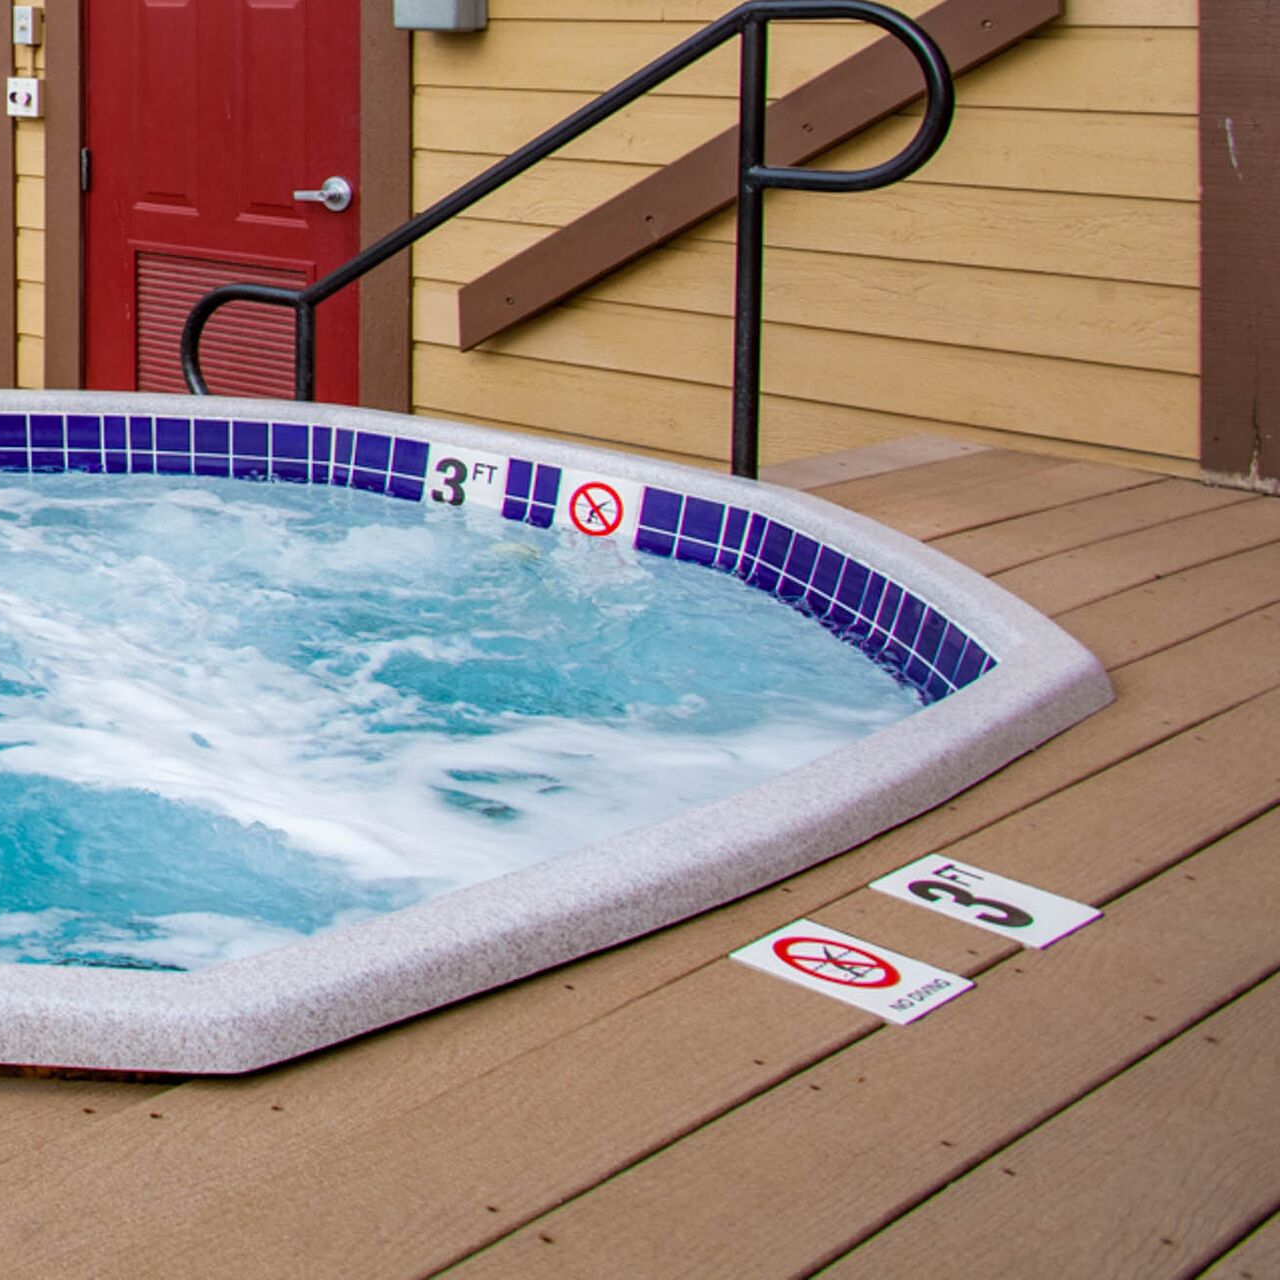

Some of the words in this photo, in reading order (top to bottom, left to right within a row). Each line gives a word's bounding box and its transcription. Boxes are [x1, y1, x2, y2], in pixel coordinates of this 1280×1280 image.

[431, 457, 468, 507] 3
[473, 463, 498, 484] FT
[932, 863, 985, 888] FT
[907, 879, 1034, 928] 3
[888, 998, 915, 1011] NO
[906, 978, 952, 1001] DIVING
